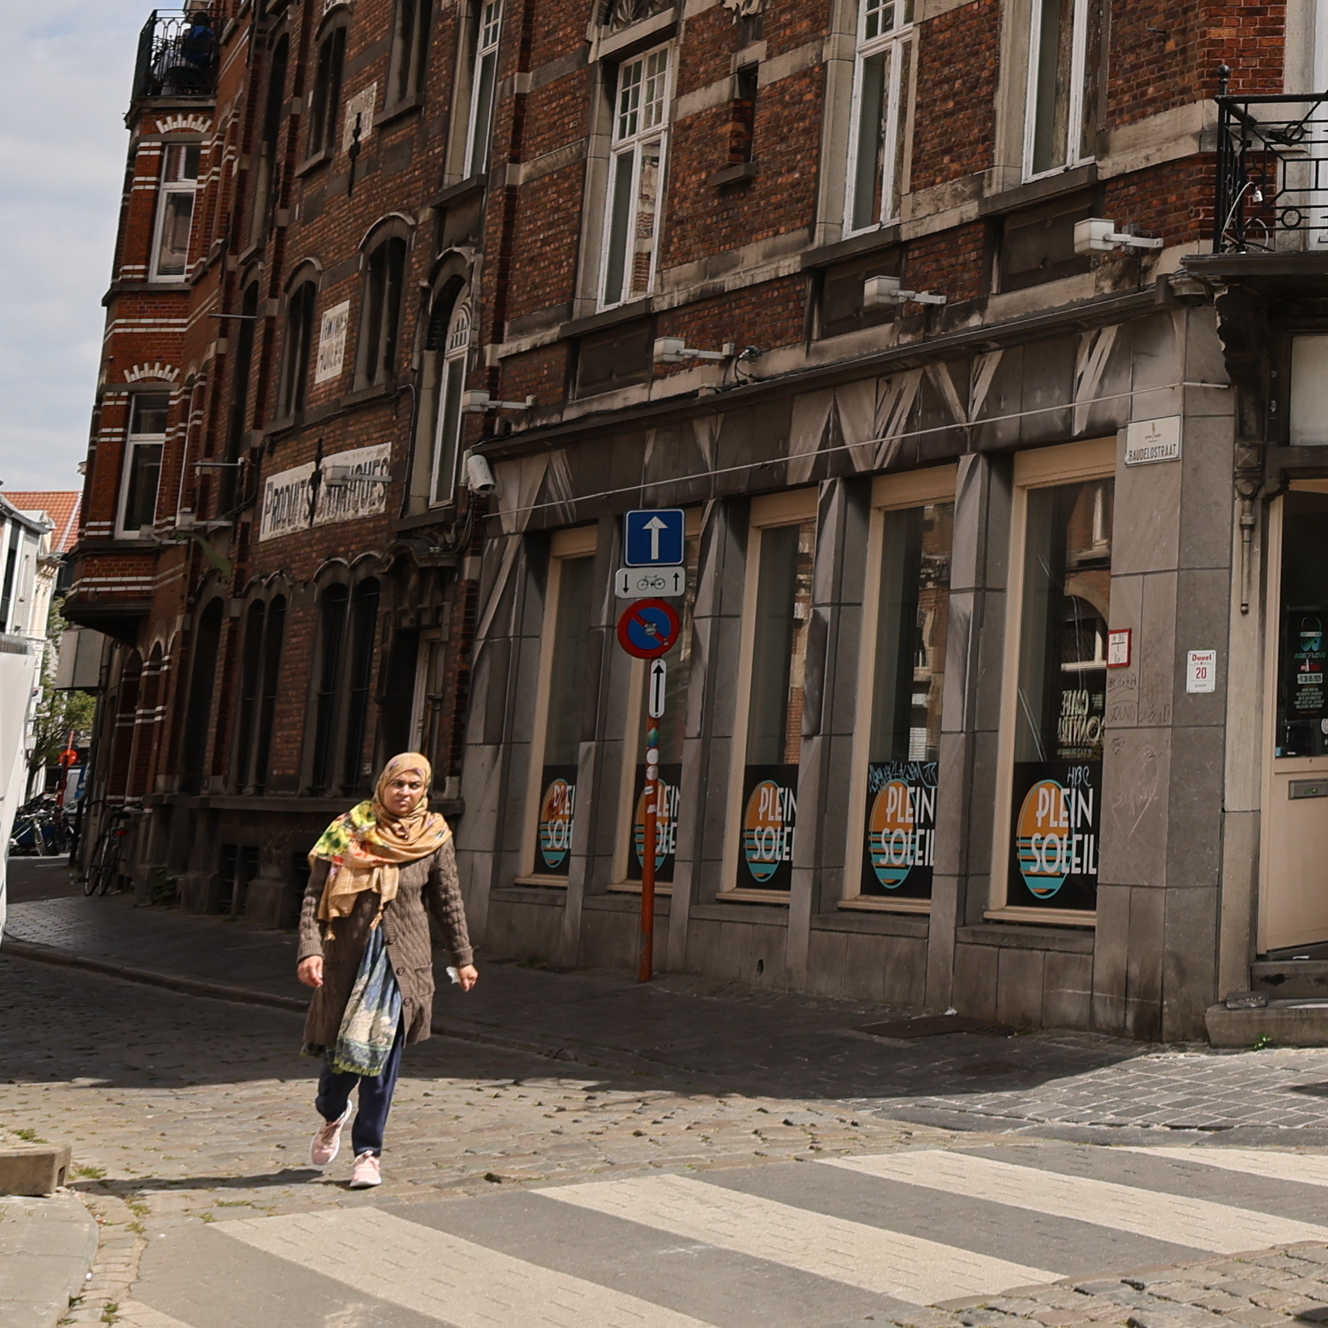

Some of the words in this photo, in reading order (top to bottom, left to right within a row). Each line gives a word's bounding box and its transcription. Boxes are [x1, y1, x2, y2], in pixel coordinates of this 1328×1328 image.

[1127, 443, 1177, 462] BAUDELOSTRAAT
[1192, 653, 1212, 661] Duvel
[1196, 667, 1207, 679] 20
[553, 785, 576, 815] PLEI
[886, 787, 935, 823] PLEIN
[1036, 788, 1093, 828] PLEIN
[1030, 833, 1097, 875] SOLEIL
